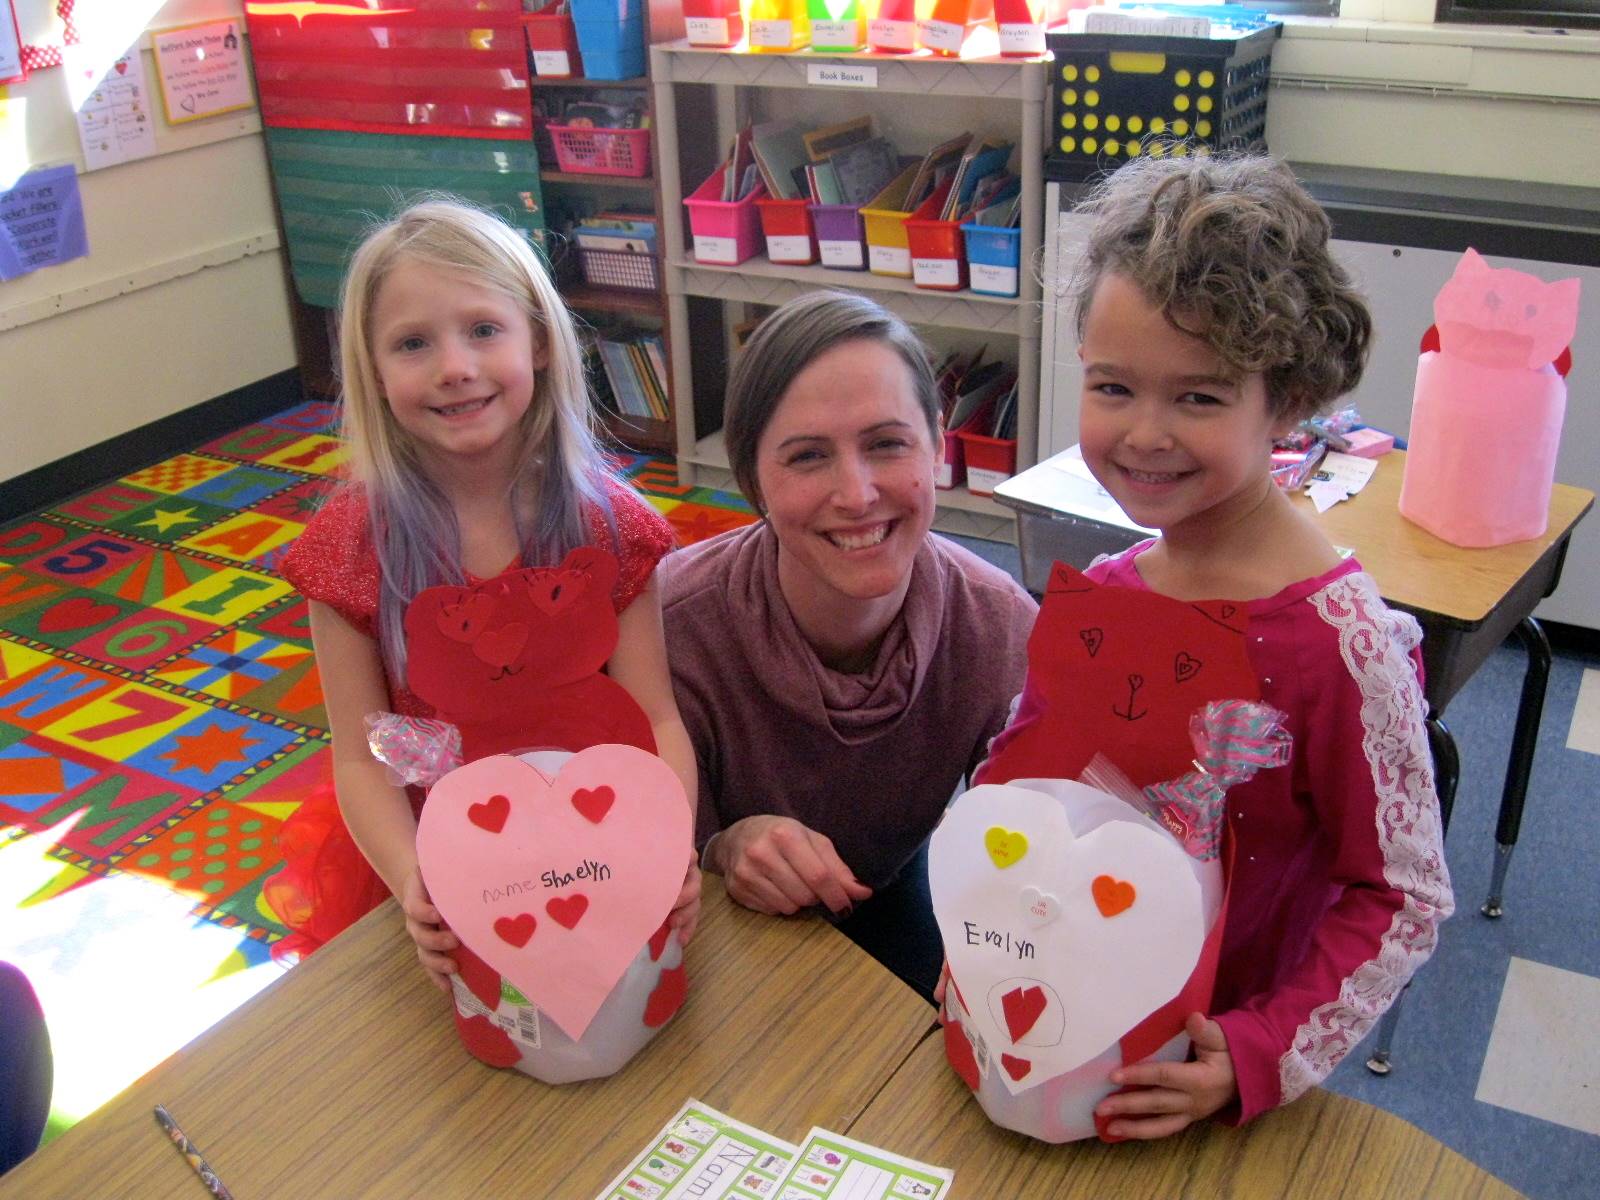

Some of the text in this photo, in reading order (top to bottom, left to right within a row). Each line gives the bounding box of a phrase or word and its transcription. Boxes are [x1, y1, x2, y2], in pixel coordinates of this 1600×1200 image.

[820, 71, 864, 82] Book Boxes
[57, 483, 161, 522] E
[194, 519, 285, 556] A
[43, 540, 134, 575] 5
[105, 620, 189, 658] 6
[0, 665, 109, 719] W
[67, 689, 192, 743] 7
[36, 774, 182, 847] M
[482, 859, 611, 904] name Shaelyn
[963, 921, 1035, 960] Evalyn
